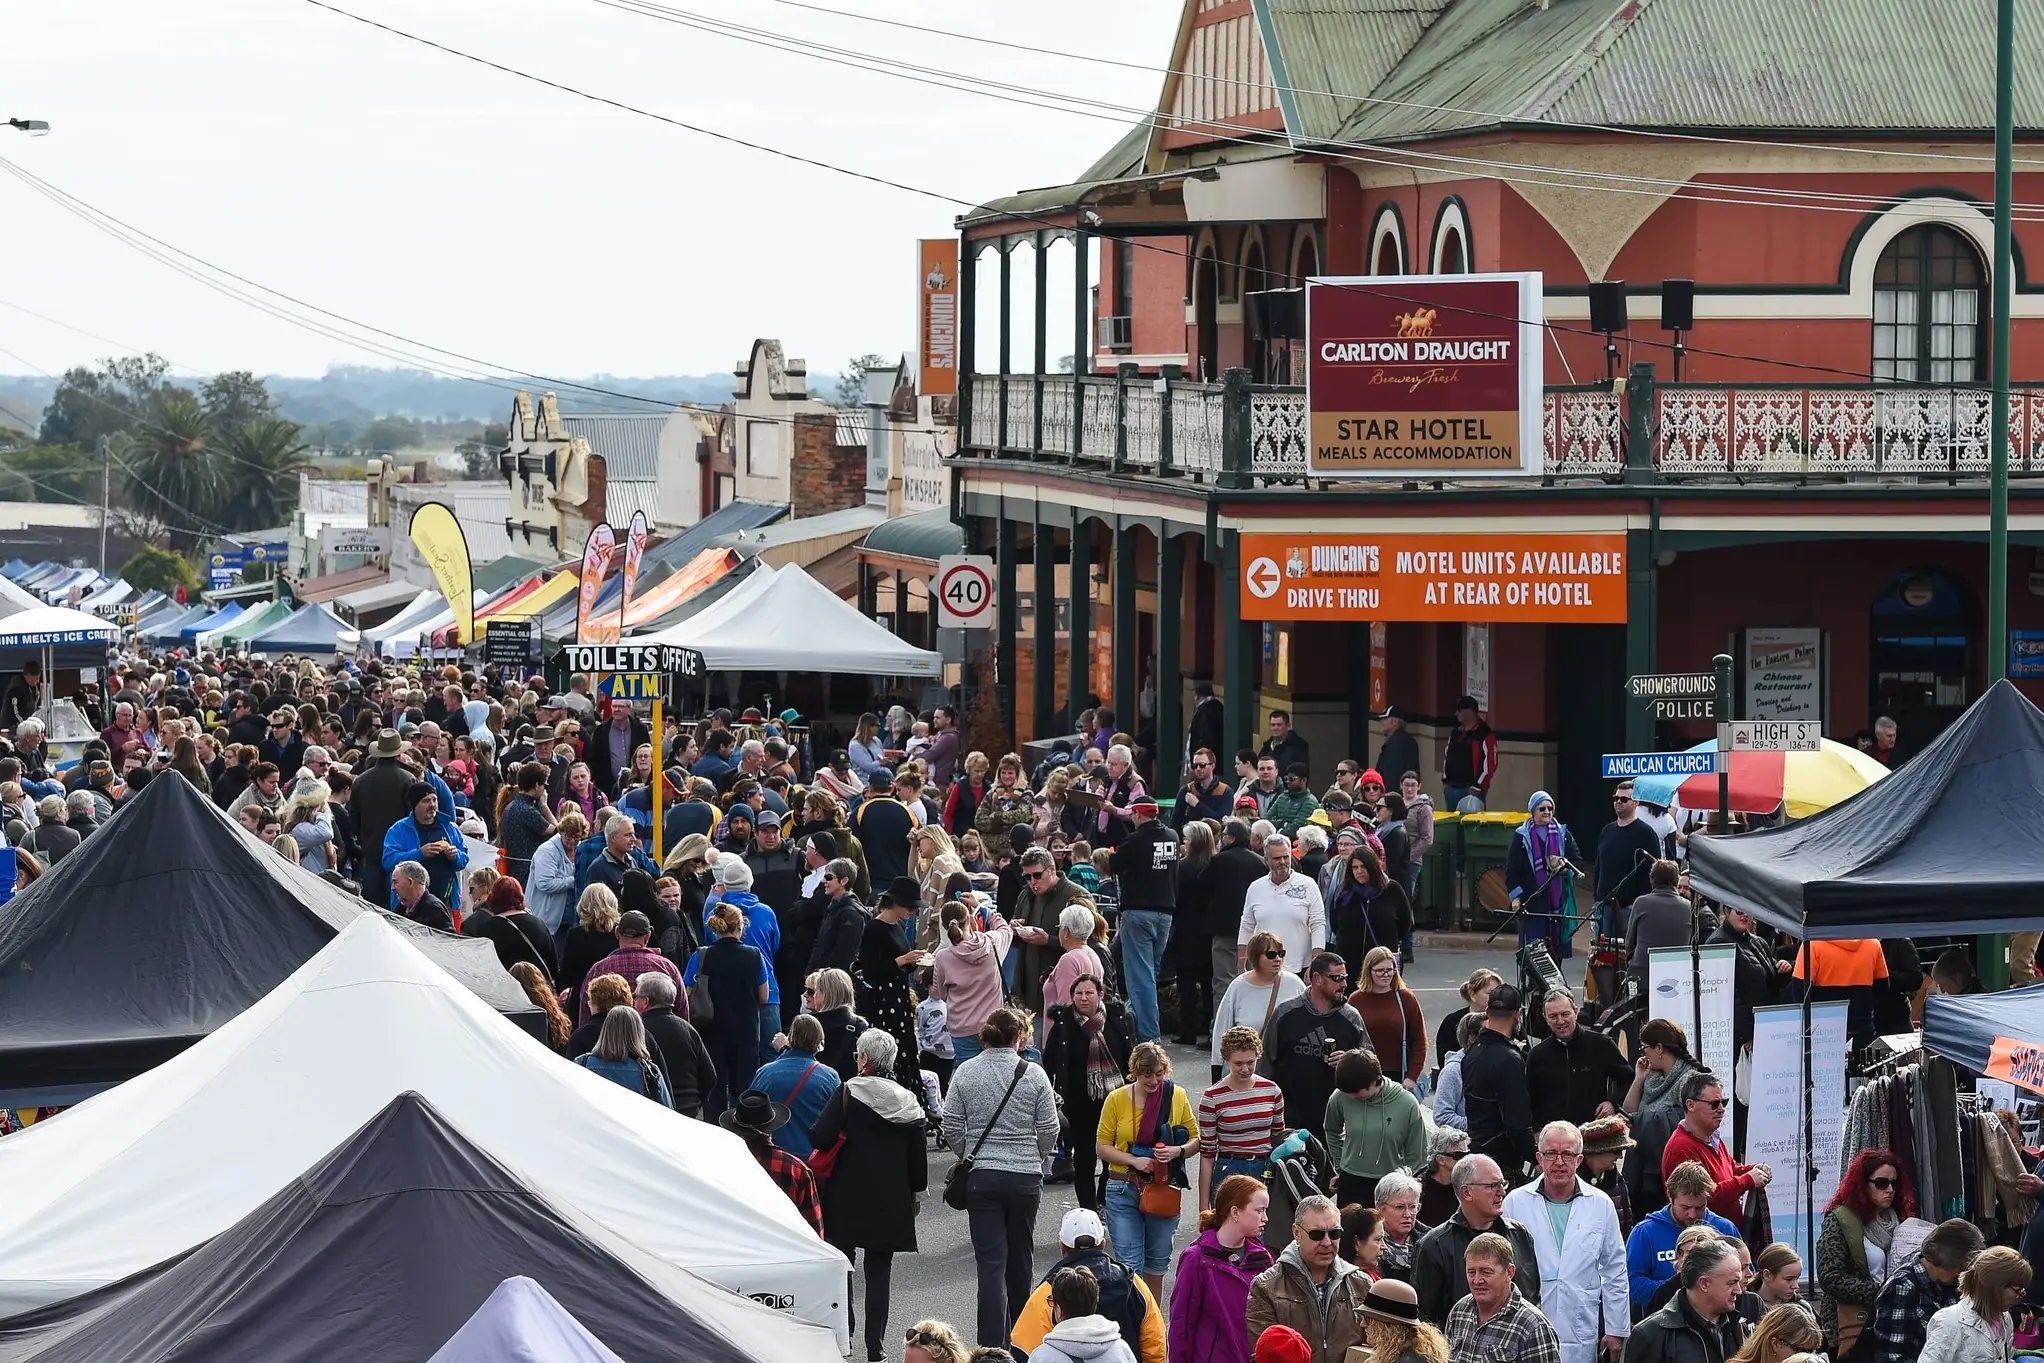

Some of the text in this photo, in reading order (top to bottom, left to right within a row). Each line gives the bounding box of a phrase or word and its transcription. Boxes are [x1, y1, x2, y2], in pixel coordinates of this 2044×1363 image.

[931, 293, 954, 369] DUNCAN'S
[1321, 340, 1510, 362] CARLTON DRAUGHT
[1368, 368, 1460, 393] Brewery Fresh
[1337, 418, 1492, 441] STAR HOTEL
[1318, 446, 1512, 460] MEALS ACCOMMODATION
[1311, 545, 1380, 572] DUNCAN'S
[1396, 551, 1621, 575] MOTEL UNITS AVAILABLE
[947, 580, 982, 603] 40
[1287, 588, 1380, 609] DRIVE THRU
[1424, 582, 1593, 606] AT REAR OF HOTEL
[22, 633, 60, 644] MELTS
[64, 632, 83, 642] ICE
[566, 647, 697, 676] TOILETS OFFICE
[1765, 652, 1790, 666] Eastern
[1794, 646, 1815, 658] Palace
[611, 674, 659, 698] ATM
[1632, 675, 1716, 695] SHOWGROUNDS
[1753, 682, 1812, 691] Restaurant
[1763, 672, 1803, 681] Chinese
[1656, 701, 1714, 718] POLICE
[1755, 694, 1792, 708] Dancing and
[1776, 702, 1801, 714] Drinking
[1753, 724, 1789, 741] HIGH
[1751, 741, 1816, 750] 129-75 136-78
[1607, 754, 1711, 775] ANGLICAN CHURCH
[1153, 841, 1175, 857] 30
